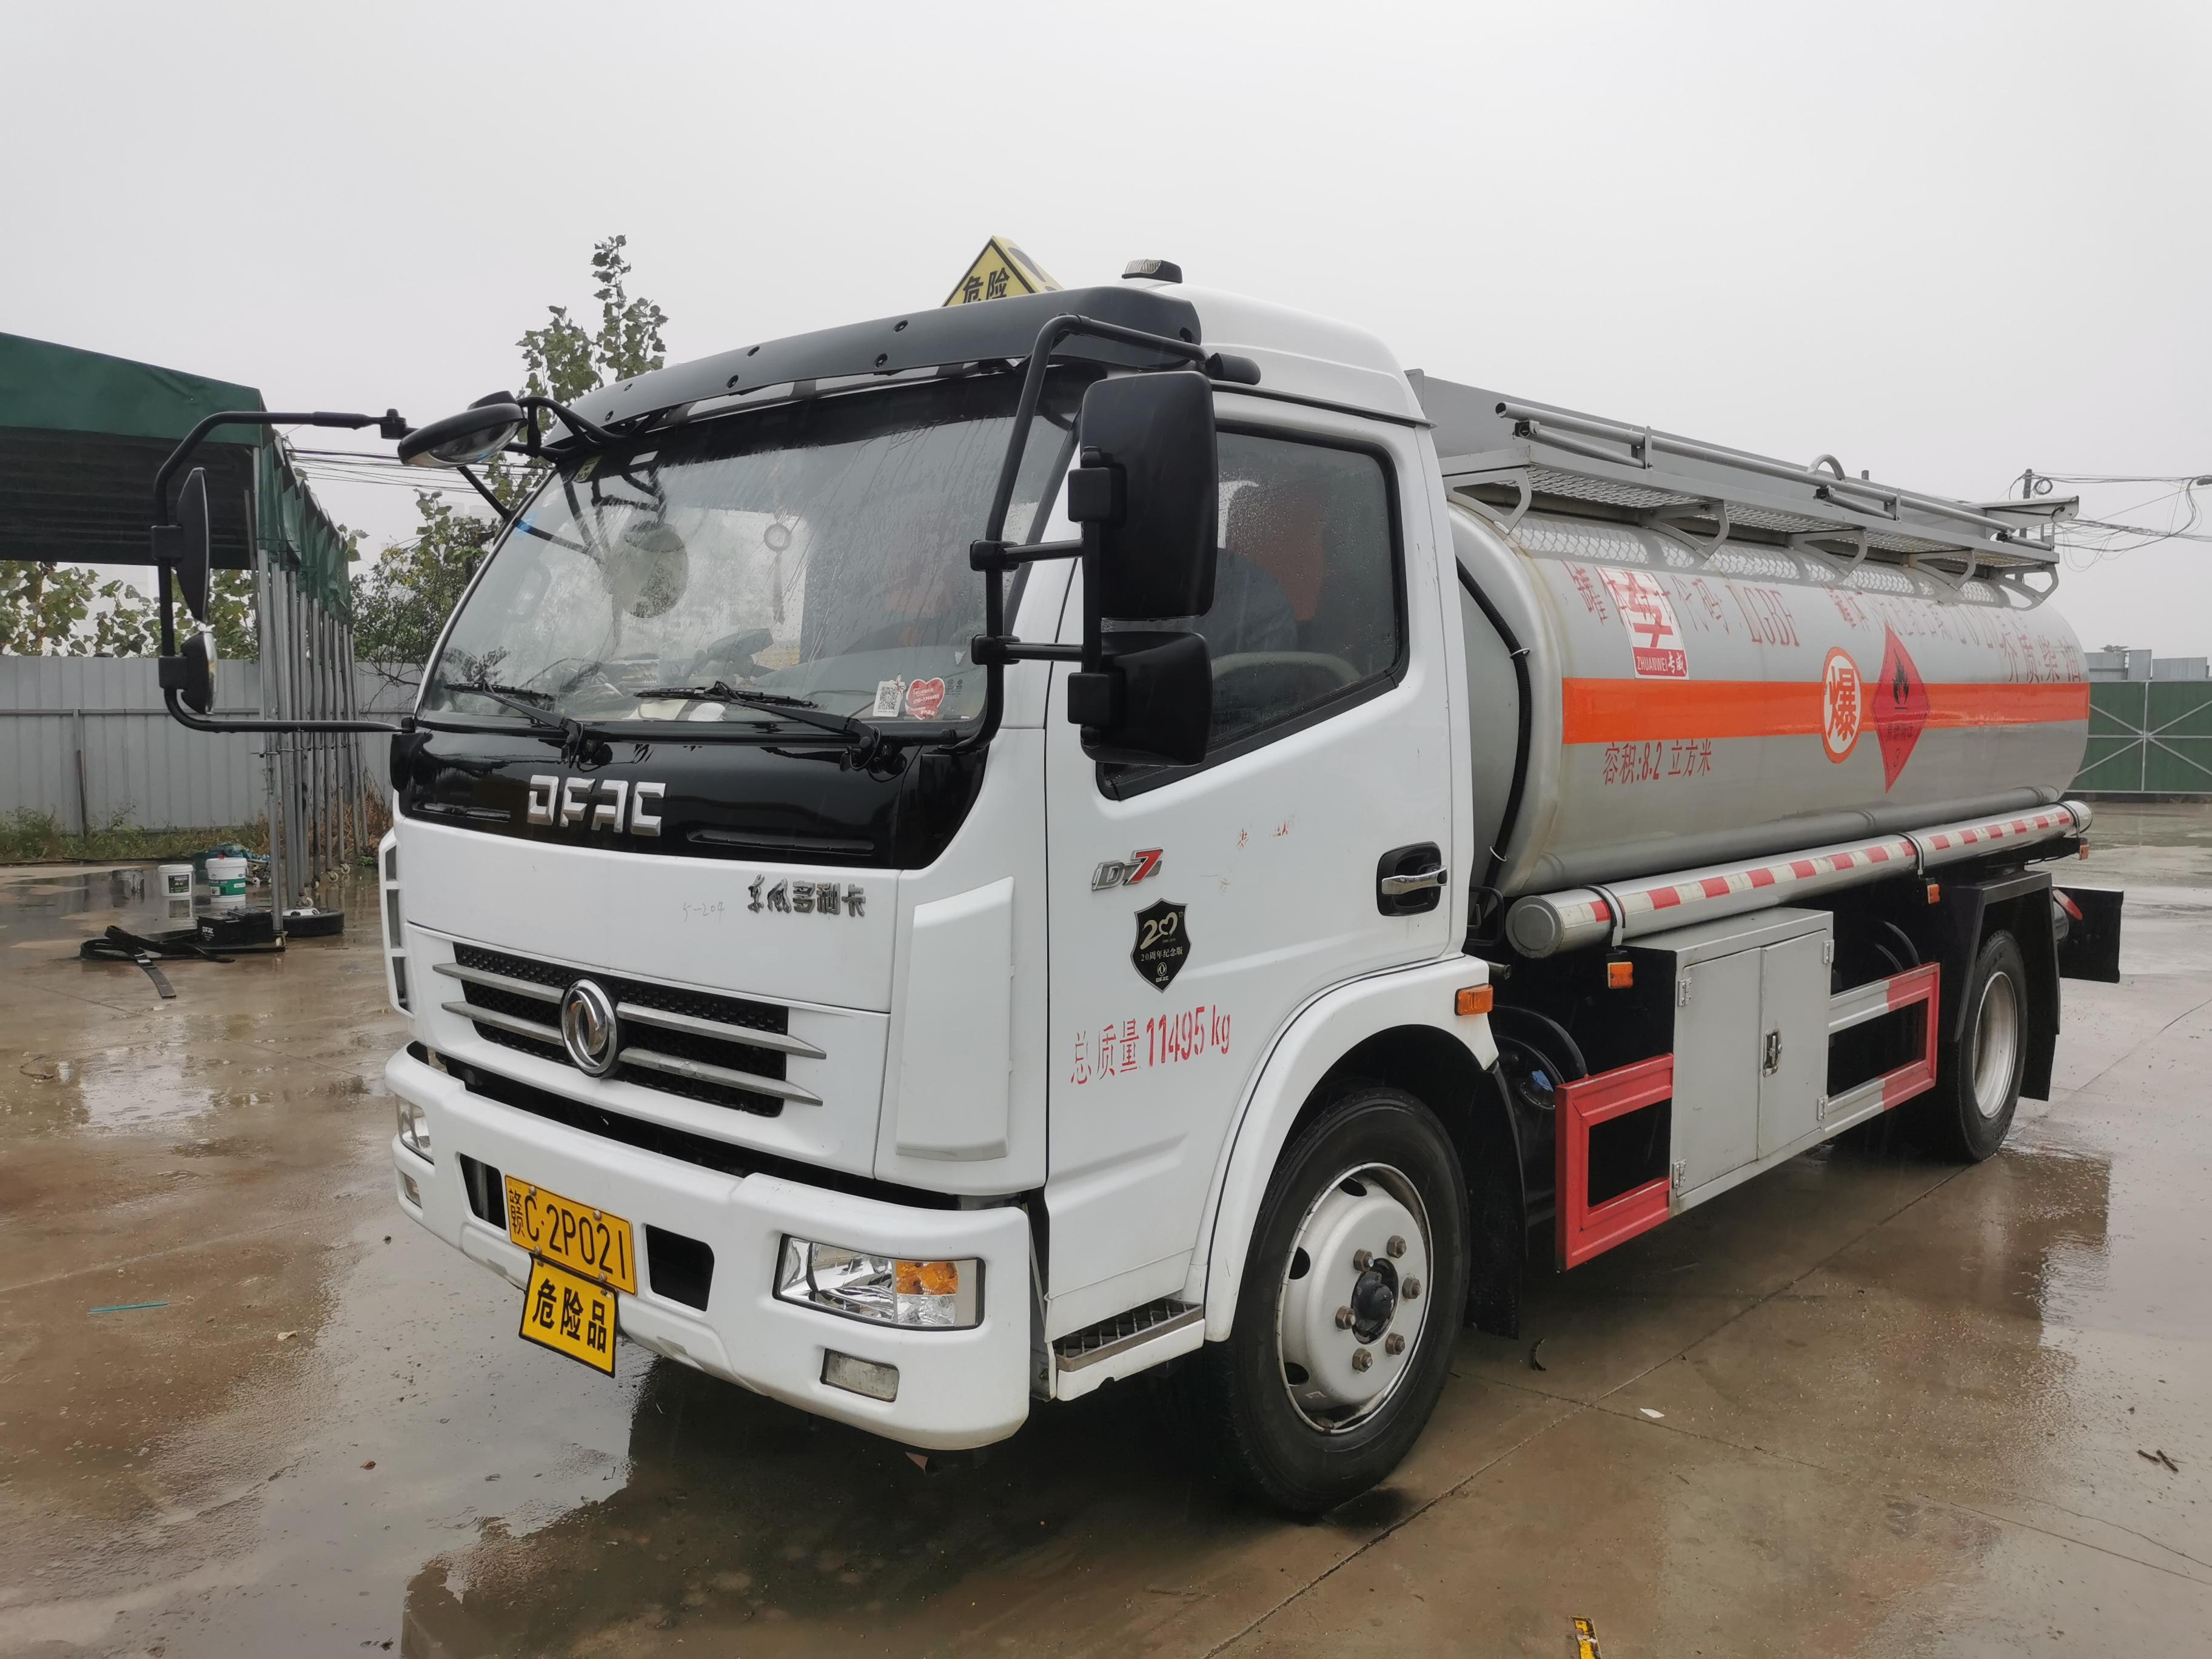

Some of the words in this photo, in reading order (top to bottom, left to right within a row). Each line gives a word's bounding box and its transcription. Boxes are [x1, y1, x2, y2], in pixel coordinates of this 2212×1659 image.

[963, 267, 1010, 304] 危险
[1637, 655, 1667, 672] ZHUANWEI
[1827, 665, 1857, 742] 爆
[528, 774, 666, 837] DFAC
[1092, 847, 1164, 891] D7
[748, 874, 866, 917] 东风多利卡
[1141, 946, 1183, 962] 20周年纪念版
[532, 1277, 607, 1353] 危险品
